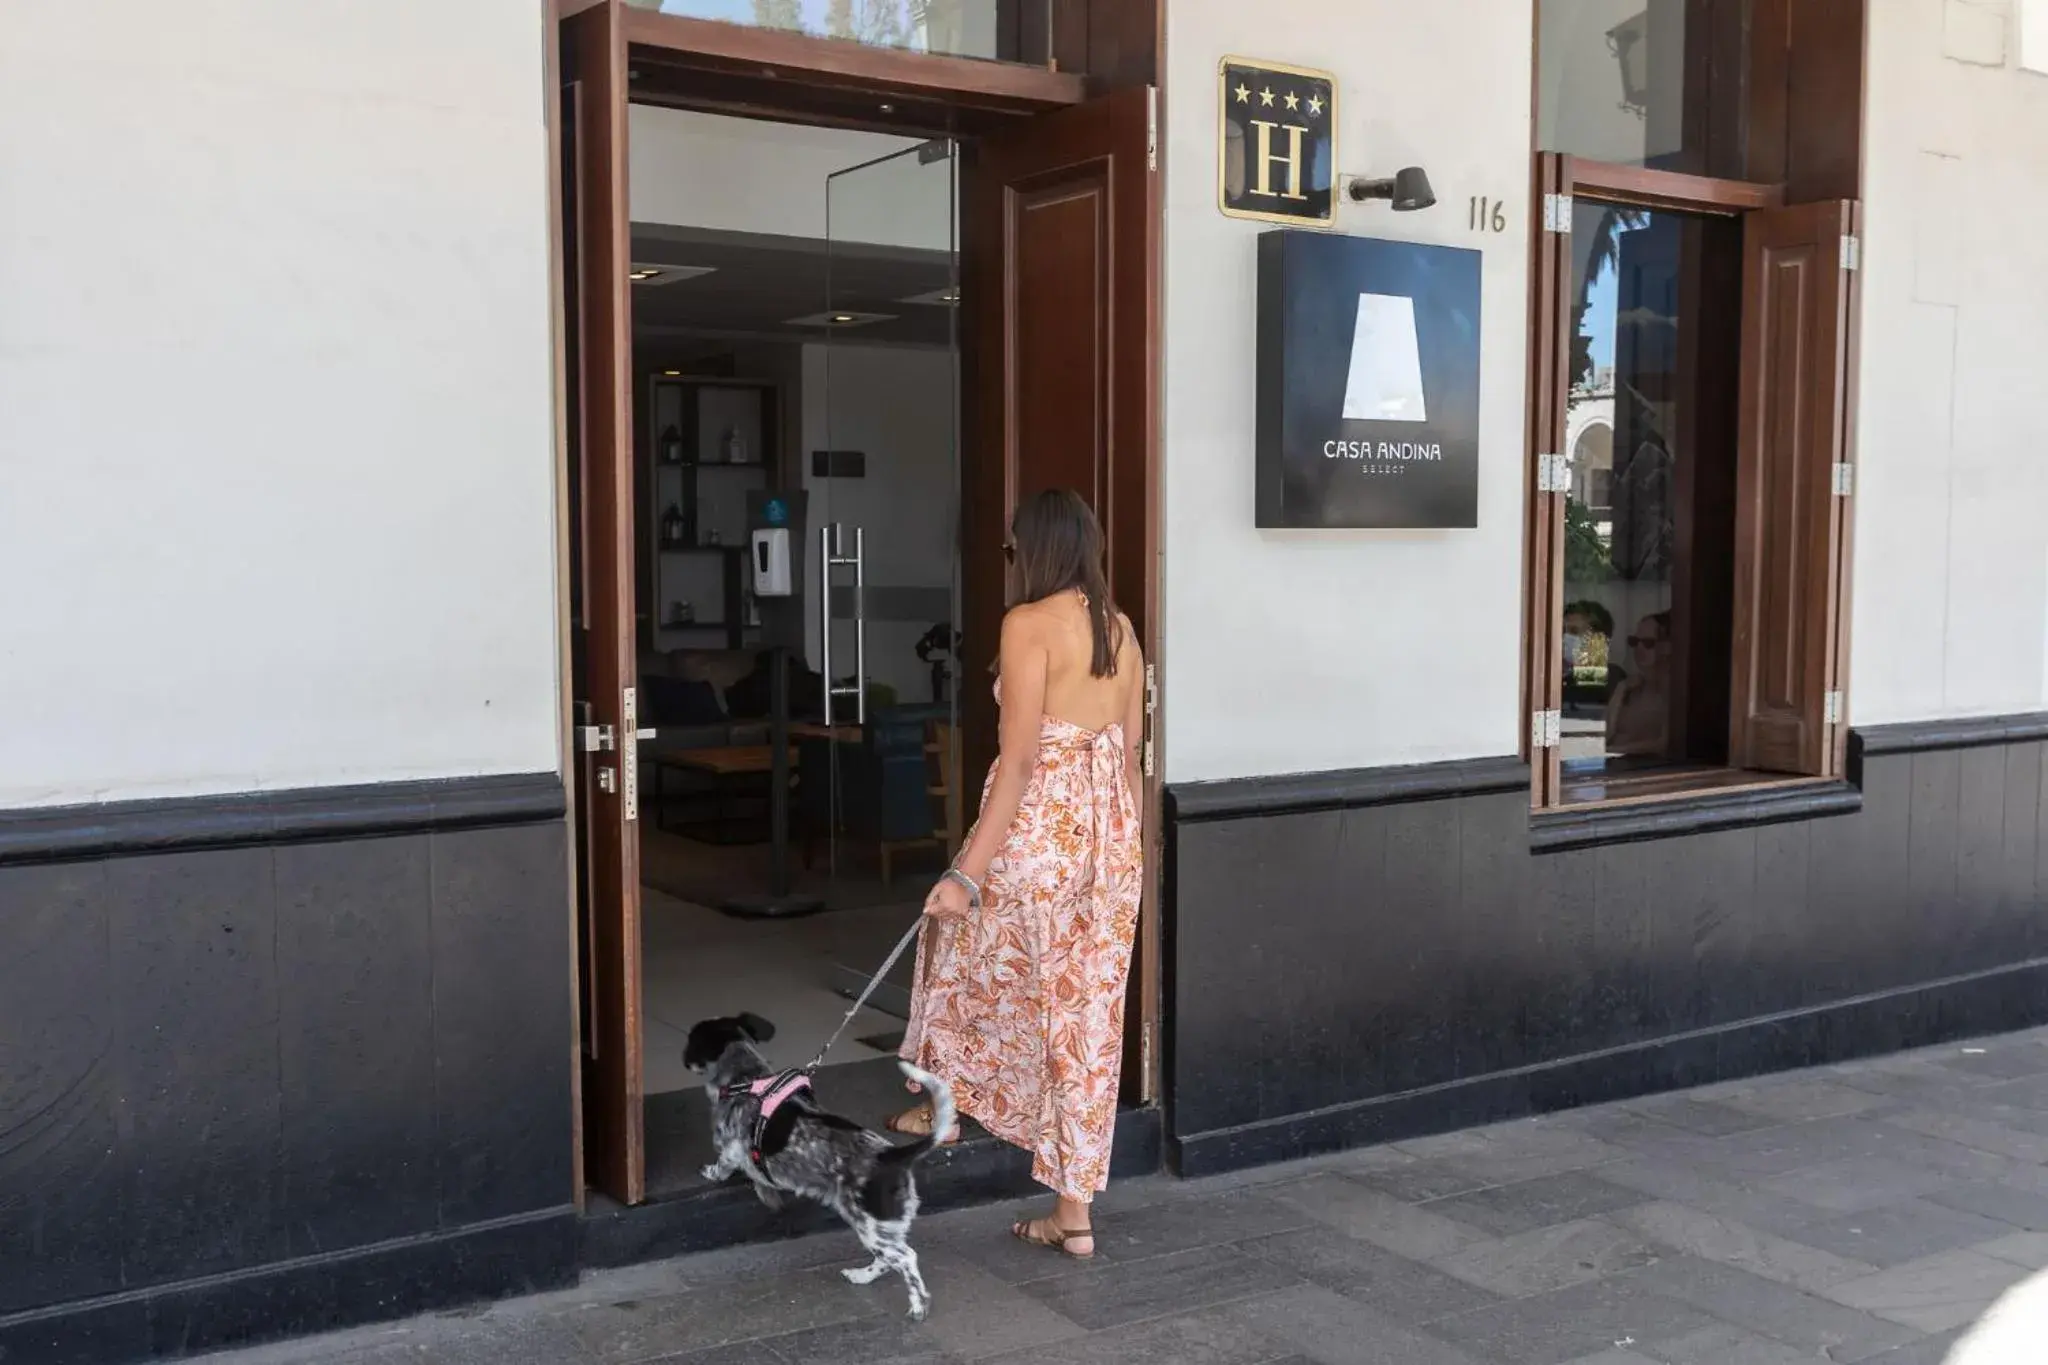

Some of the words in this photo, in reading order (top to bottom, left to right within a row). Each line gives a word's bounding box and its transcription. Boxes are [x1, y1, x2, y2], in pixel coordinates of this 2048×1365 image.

[1250, 120, 1308, 200] H
[1469, 196, 1505, 232] 116
[1323, 440, 1371, 459] CASA
[1377, 442, 1441, 460] ANDINA
[1362, 464, 1405, 474] SELECT
